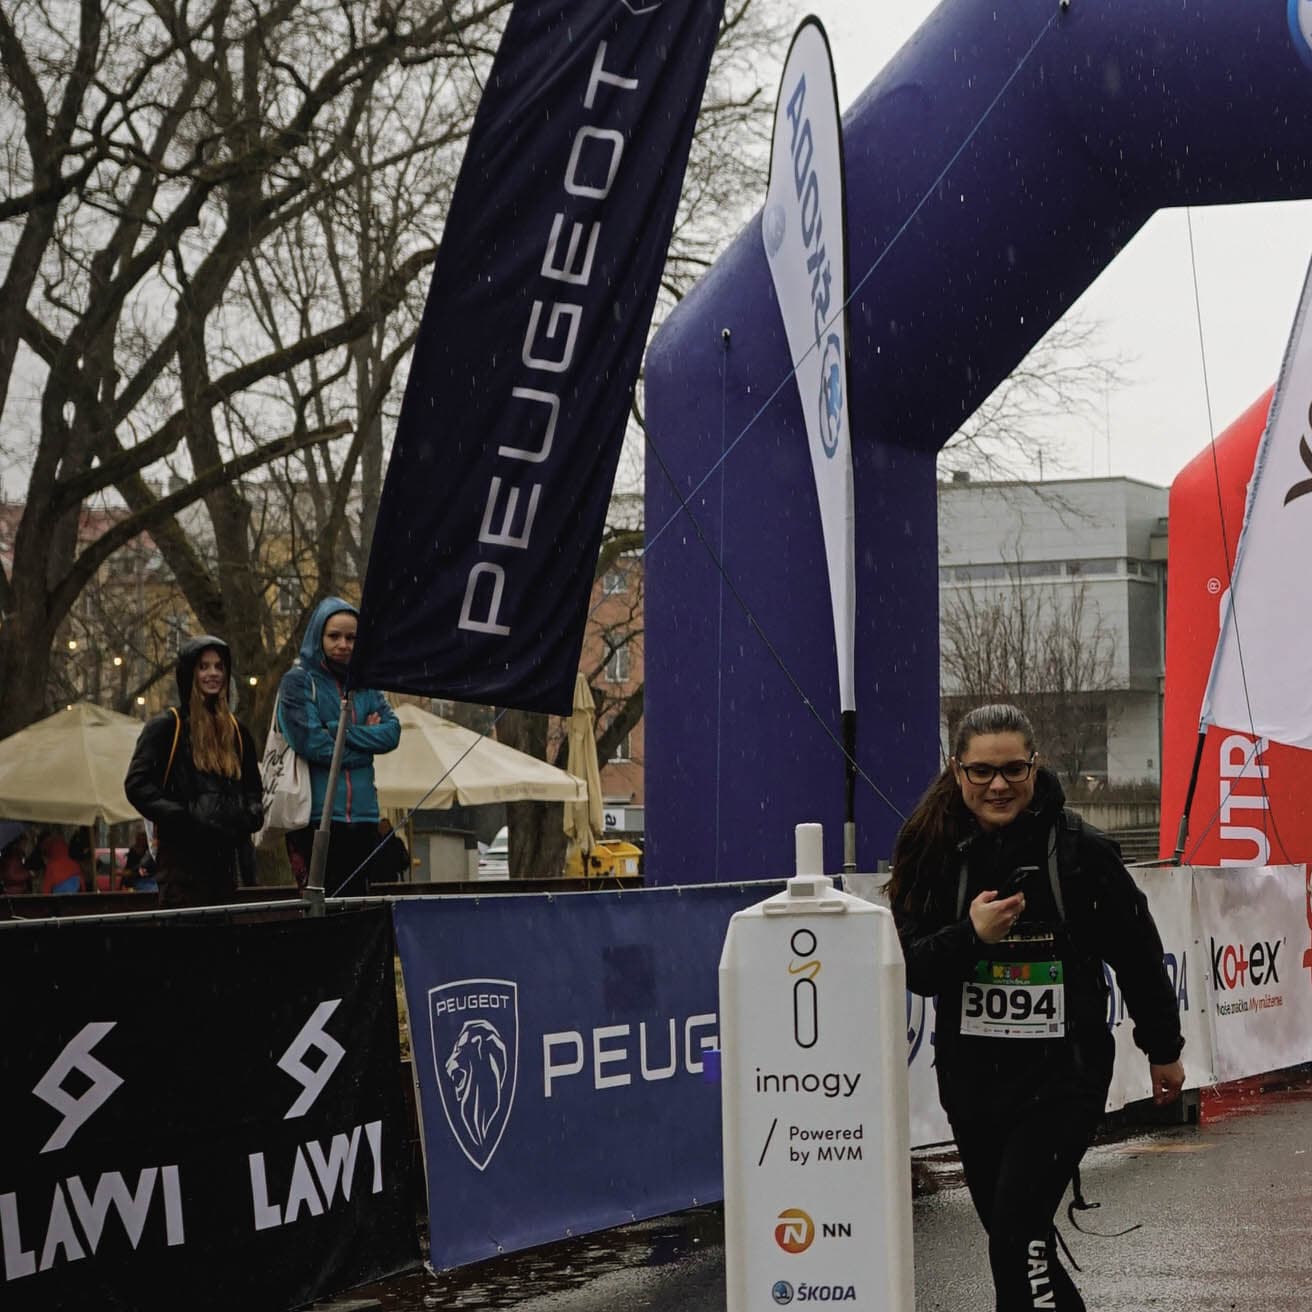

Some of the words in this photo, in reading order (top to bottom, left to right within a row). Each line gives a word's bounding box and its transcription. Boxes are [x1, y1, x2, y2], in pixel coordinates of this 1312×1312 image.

[458, 41, 639, 637] PEUGEOT
[1210, 936, 1281, 991] kotex
[436, 993, 510, 1017] PEUGEOT
[965, 986, 1056, 1020] 3094
[542, 1013, 721, 1098] PEUG
[756, 1068, 861, 1098] innogy
[789, 1124, 863, 1140] Powered
[789, 1146, 810, 1166] by
[817, 1146, 863, 1161] MVM
[249, 1120, 383, 1231] LAWI
[0, 1165, 185, 1281] LAWI
[822, 1223, 852, 1237] NN
[797, 1282, 857, 1301] ŠKODA
